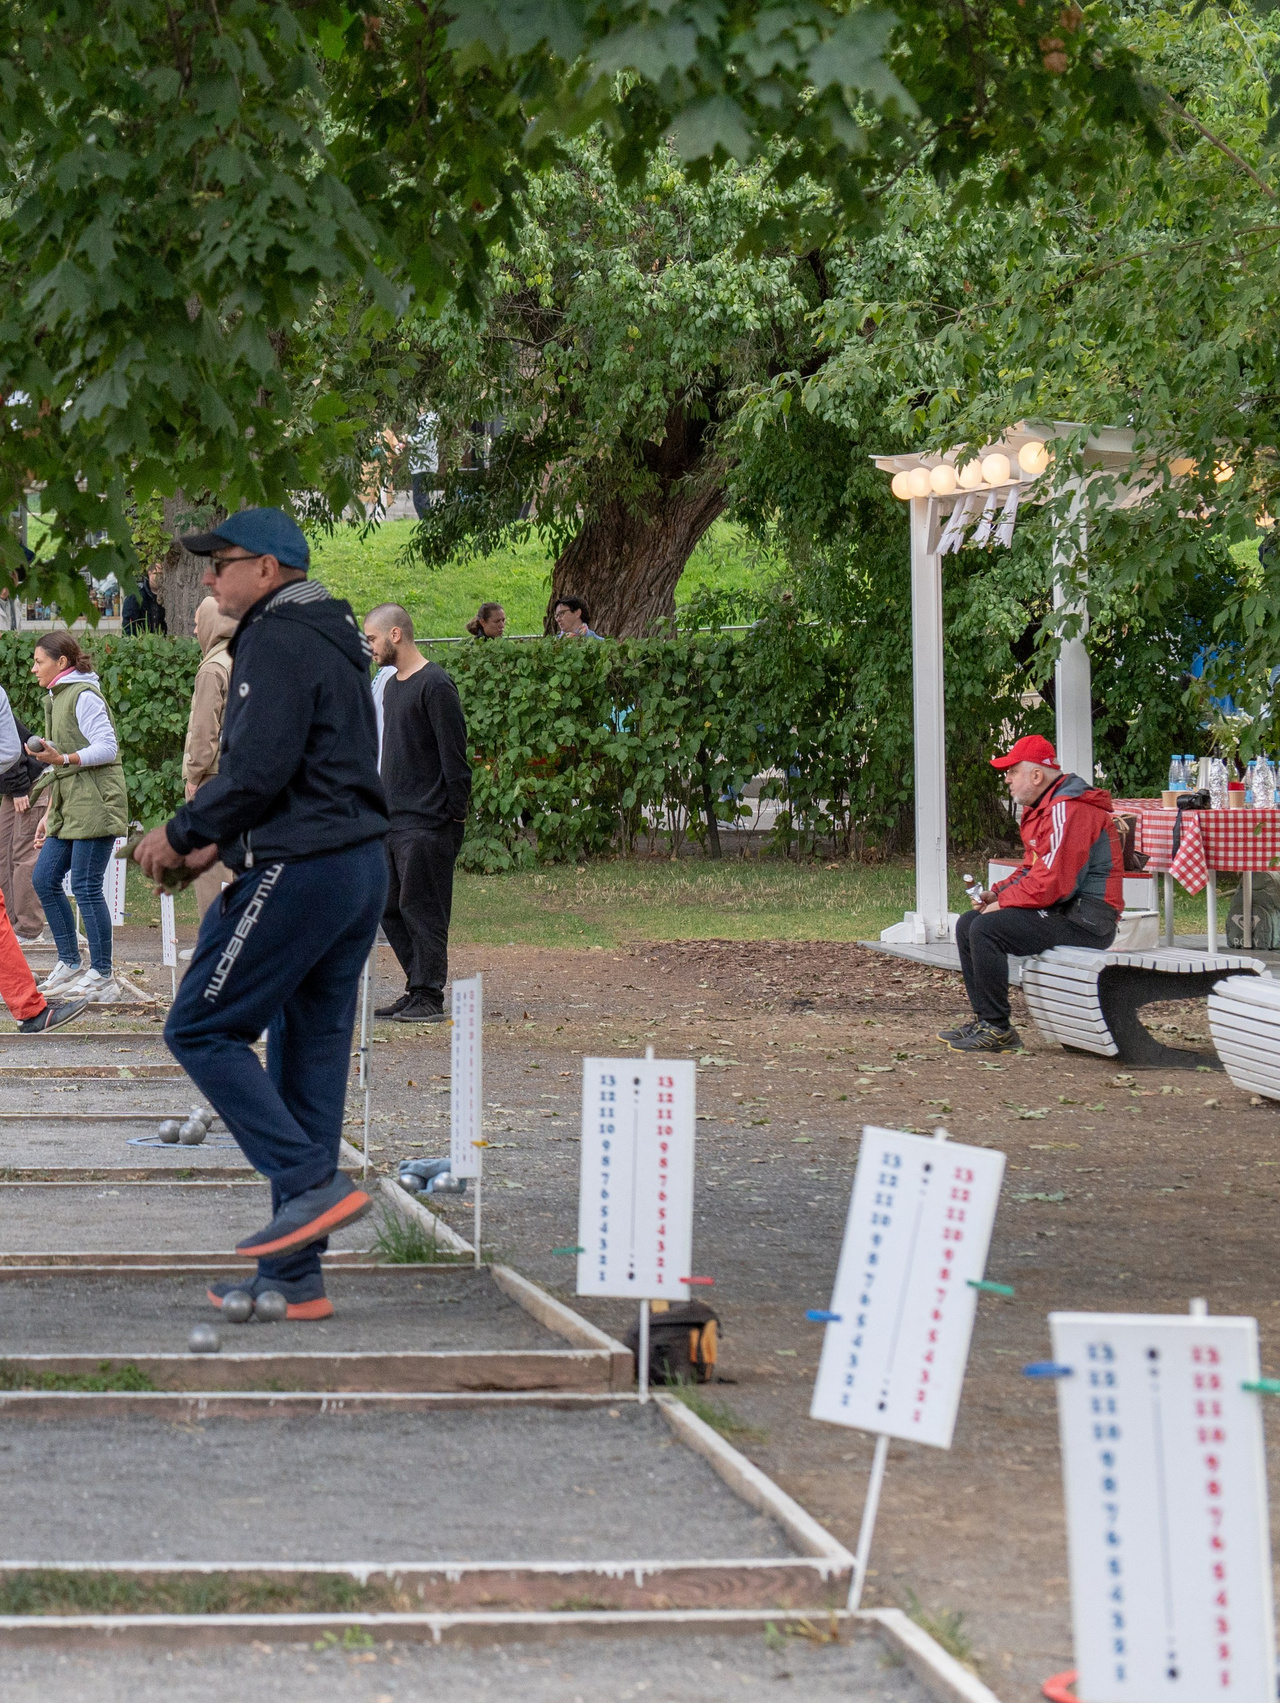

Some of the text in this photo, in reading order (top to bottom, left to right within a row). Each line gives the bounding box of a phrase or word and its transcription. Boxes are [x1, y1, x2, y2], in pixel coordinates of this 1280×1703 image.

[1233, 937, 1259, 947] ROY
[600, 1074, 617, 1087] 13
[658, 1075, 675, 1089] 13
[600, 1091, 616, 1103] 12
[657, 1092, 675, 1104] 12
[599, 1107, 615, 1118] 11
[656, 1108, 673, 1121] 11
[599, 1123, 615, 1135] 10
[656, 1124, 674, 1137] 10
[602, 1139, 611, 1151] 9
[659, 1141, 669, 1155] 9
[601, 1155, 611, 1167] 8
[659, 1156, 669, 1169] 8
[882, 1153, 902, 1169] 13
[601, 1172, 609, 1185] 7
[658, 1173, 668, 1186] 7
[879, 1172, 898, 1188] 12
[954, 1166, 974, 1184] 13
[600, 1188, 611, 1201] 6
[657, 1190, 668, 1203] 6
[875, 1192, 894, 1207] 11
[950, 1186, 971, 1203] 12
[600, 1205, 609, 1219] 5
[657, 1206, 667, 1220] 5
[945, 1206, 966, 1223] 11
[871, 1212, 891, 1228] 10
[600, 1223, 609, 1234] 4
[656, 1224, 667, 1237] 4
[942, 1226, 964, 1242] 10
[599, 1238, 608, 1251] 3
[657, 1239, 666, 1253] 3
[872, 1233, 882, 1247] 9
[599, 1254, 608, 1266] 2
[867, 1252, 879, 1267] 8
[943, 1248, 955, 1262] 9
[656, 1256, 665, 1269] 2
[599, 1271, 606, 1282] 1
[656, 1273, 664, 1285] 1
[865, 1272, 874, 1287] 7
[938, 1266, 951, 1282] 8
[860, 1292, 870, 1307] 6
[936, 1287, 947, 1302] 7
[856, 1313, 866, 1329] 5
[931, 1308, 943, 1322] 6
[852, 1334, 863, 1348] 4
[927, 1328, 938, 1344] 5
[849, 1353, 859, 1368] 3
[923, 1349, 934, 1364] 4
[845, 1373, 855, 1387] 2
[920, 1368, 930, 1384] 3
[841, 1393, 850, 1407] 1
[916, 1389, 926, 1403] 2
[913, 1409, 921, 1423] 1
